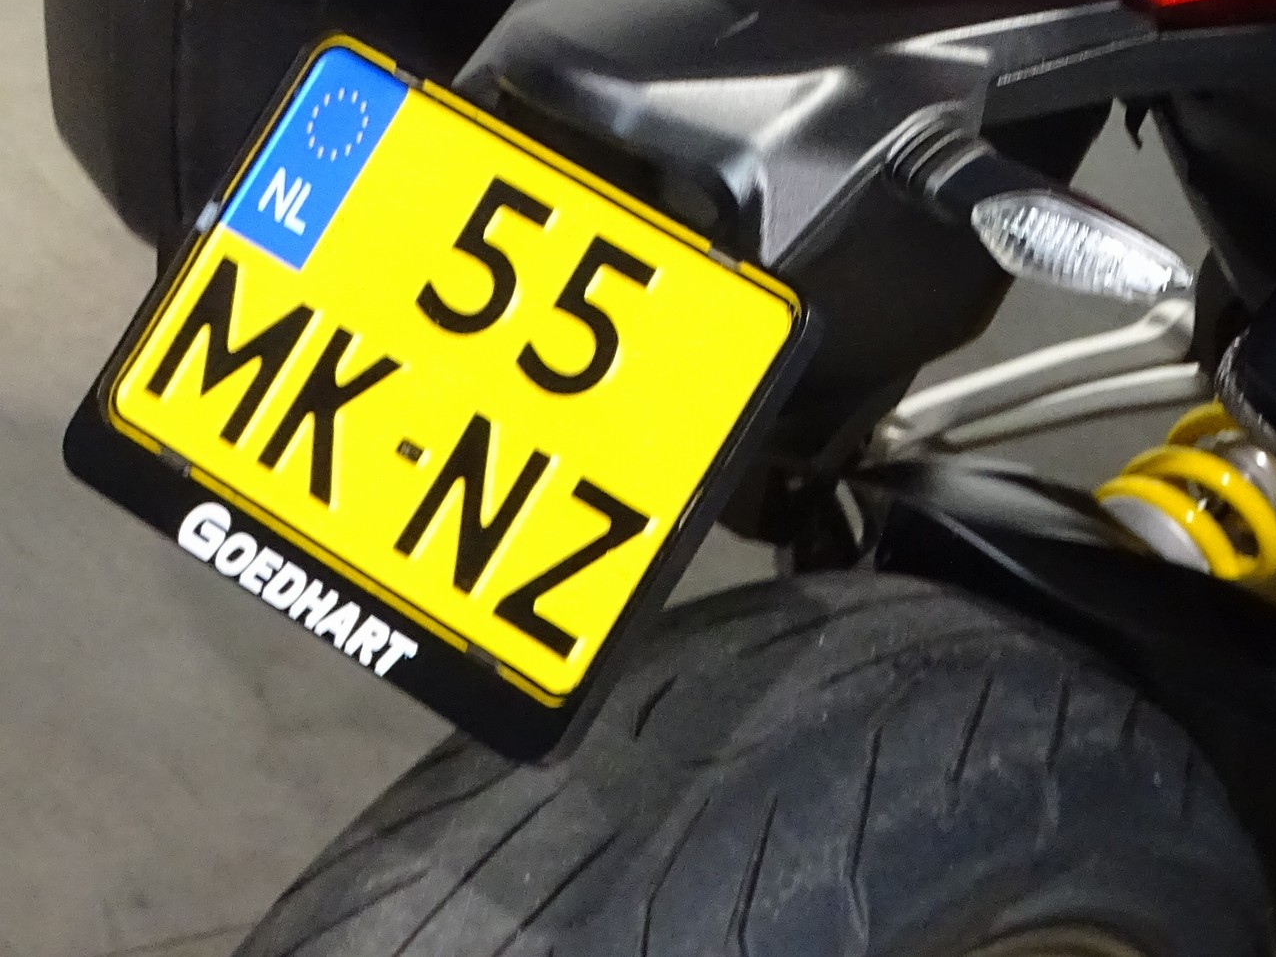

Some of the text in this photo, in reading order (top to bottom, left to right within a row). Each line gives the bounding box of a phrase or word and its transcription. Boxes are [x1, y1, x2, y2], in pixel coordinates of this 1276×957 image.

[258, 167, 310, 235] NL
[416, 176, 656, 395] 55
[147, 256, 649, 660] MK-NZ
[177, 501, 418, 676] GOEDHART
